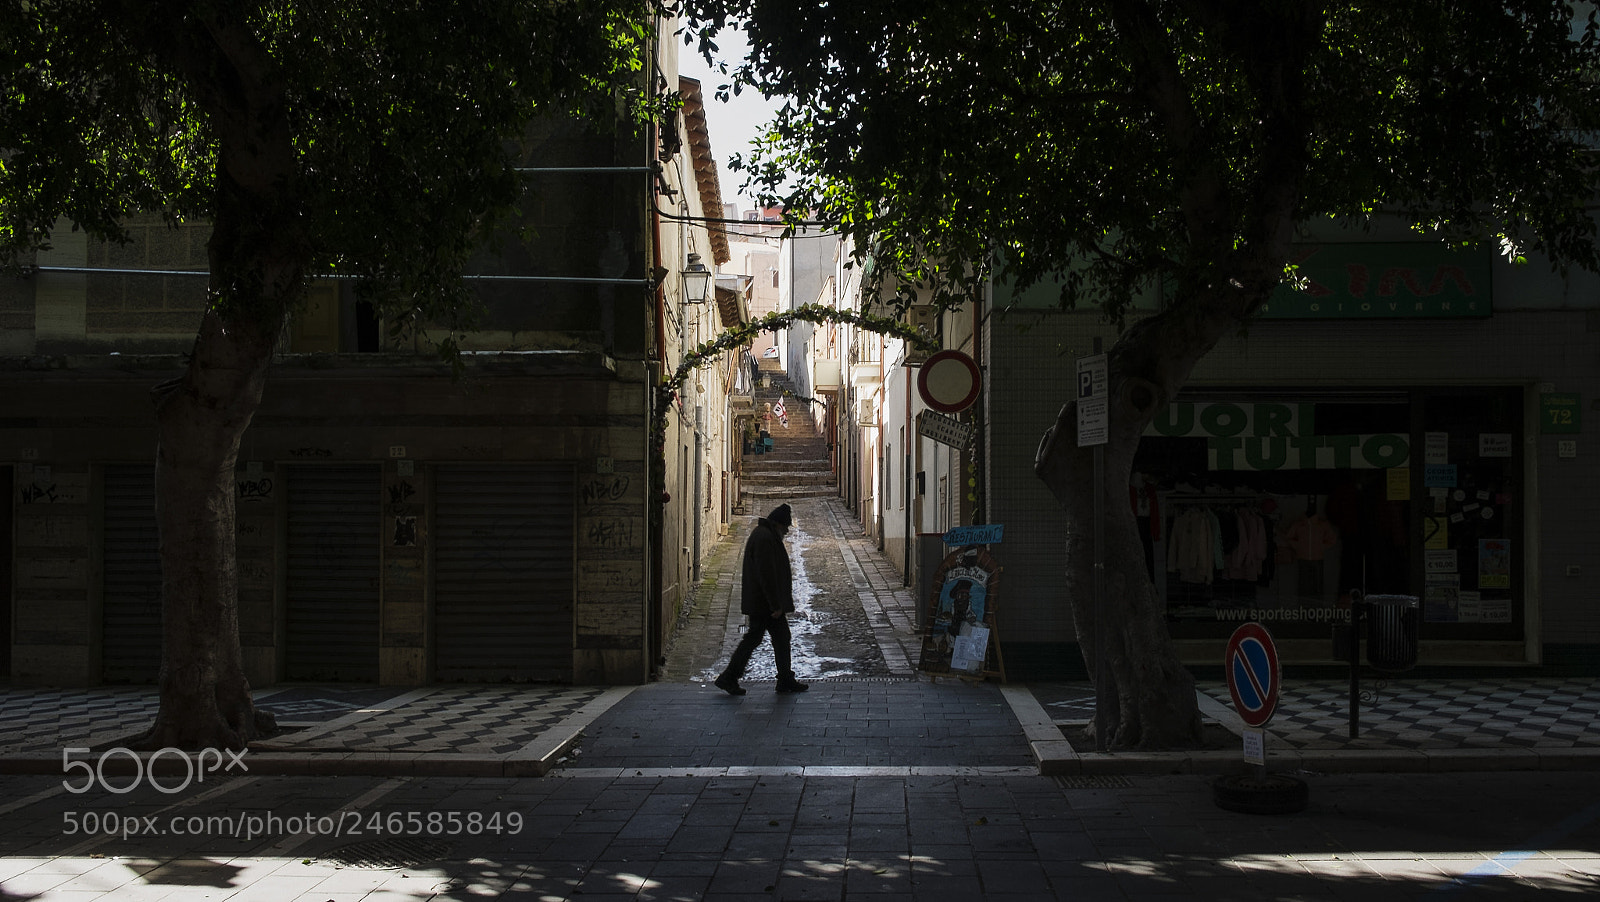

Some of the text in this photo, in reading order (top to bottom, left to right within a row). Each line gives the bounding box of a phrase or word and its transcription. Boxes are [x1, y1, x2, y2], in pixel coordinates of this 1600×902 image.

[1310, 302, 1477, 312] GIOVANE
[1153, 402, 1316, 437] UORI
[1549, 409, 1572, 424] 72
[1208, 433, 1410, 469] TUTTO
[1215, 605, 1366, 623] www.sporteshopping
